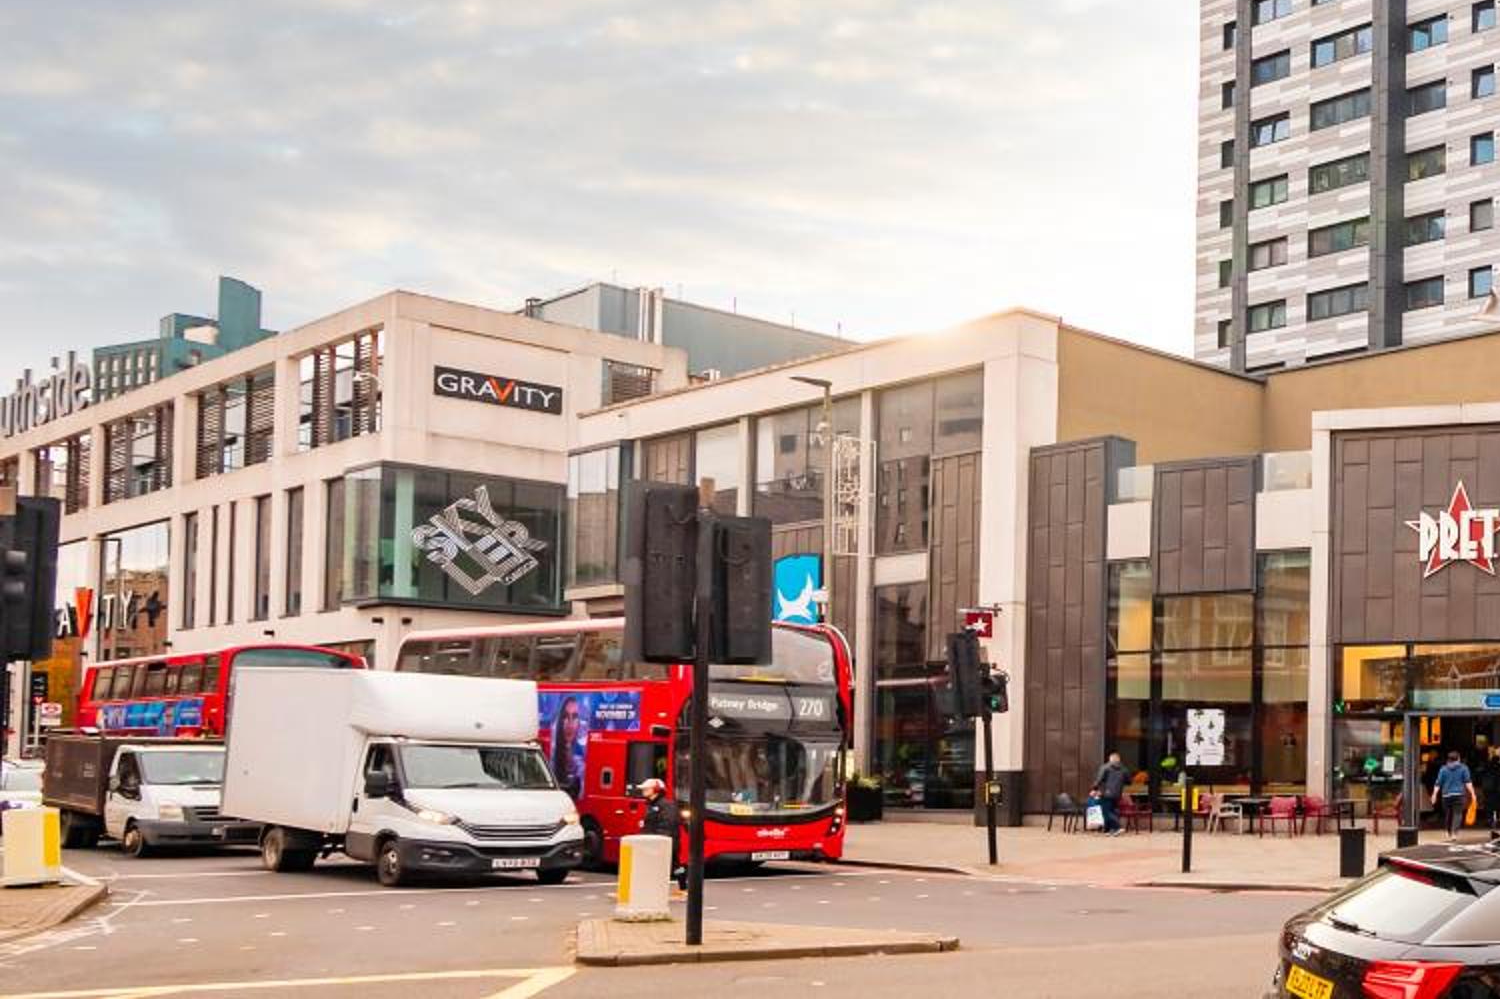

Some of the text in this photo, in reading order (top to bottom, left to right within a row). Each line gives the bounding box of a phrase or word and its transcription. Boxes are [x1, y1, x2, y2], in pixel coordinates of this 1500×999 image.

[0, 350, 91, 438] uthside
[437, 373, 555, 408] GRAVITY
[1419, 508, 1500, 562] PRET
[56, 586, 133, 639] AVITY
[747, 699, 779, 712] Bridge
[799, 698, 823, 717] 270
